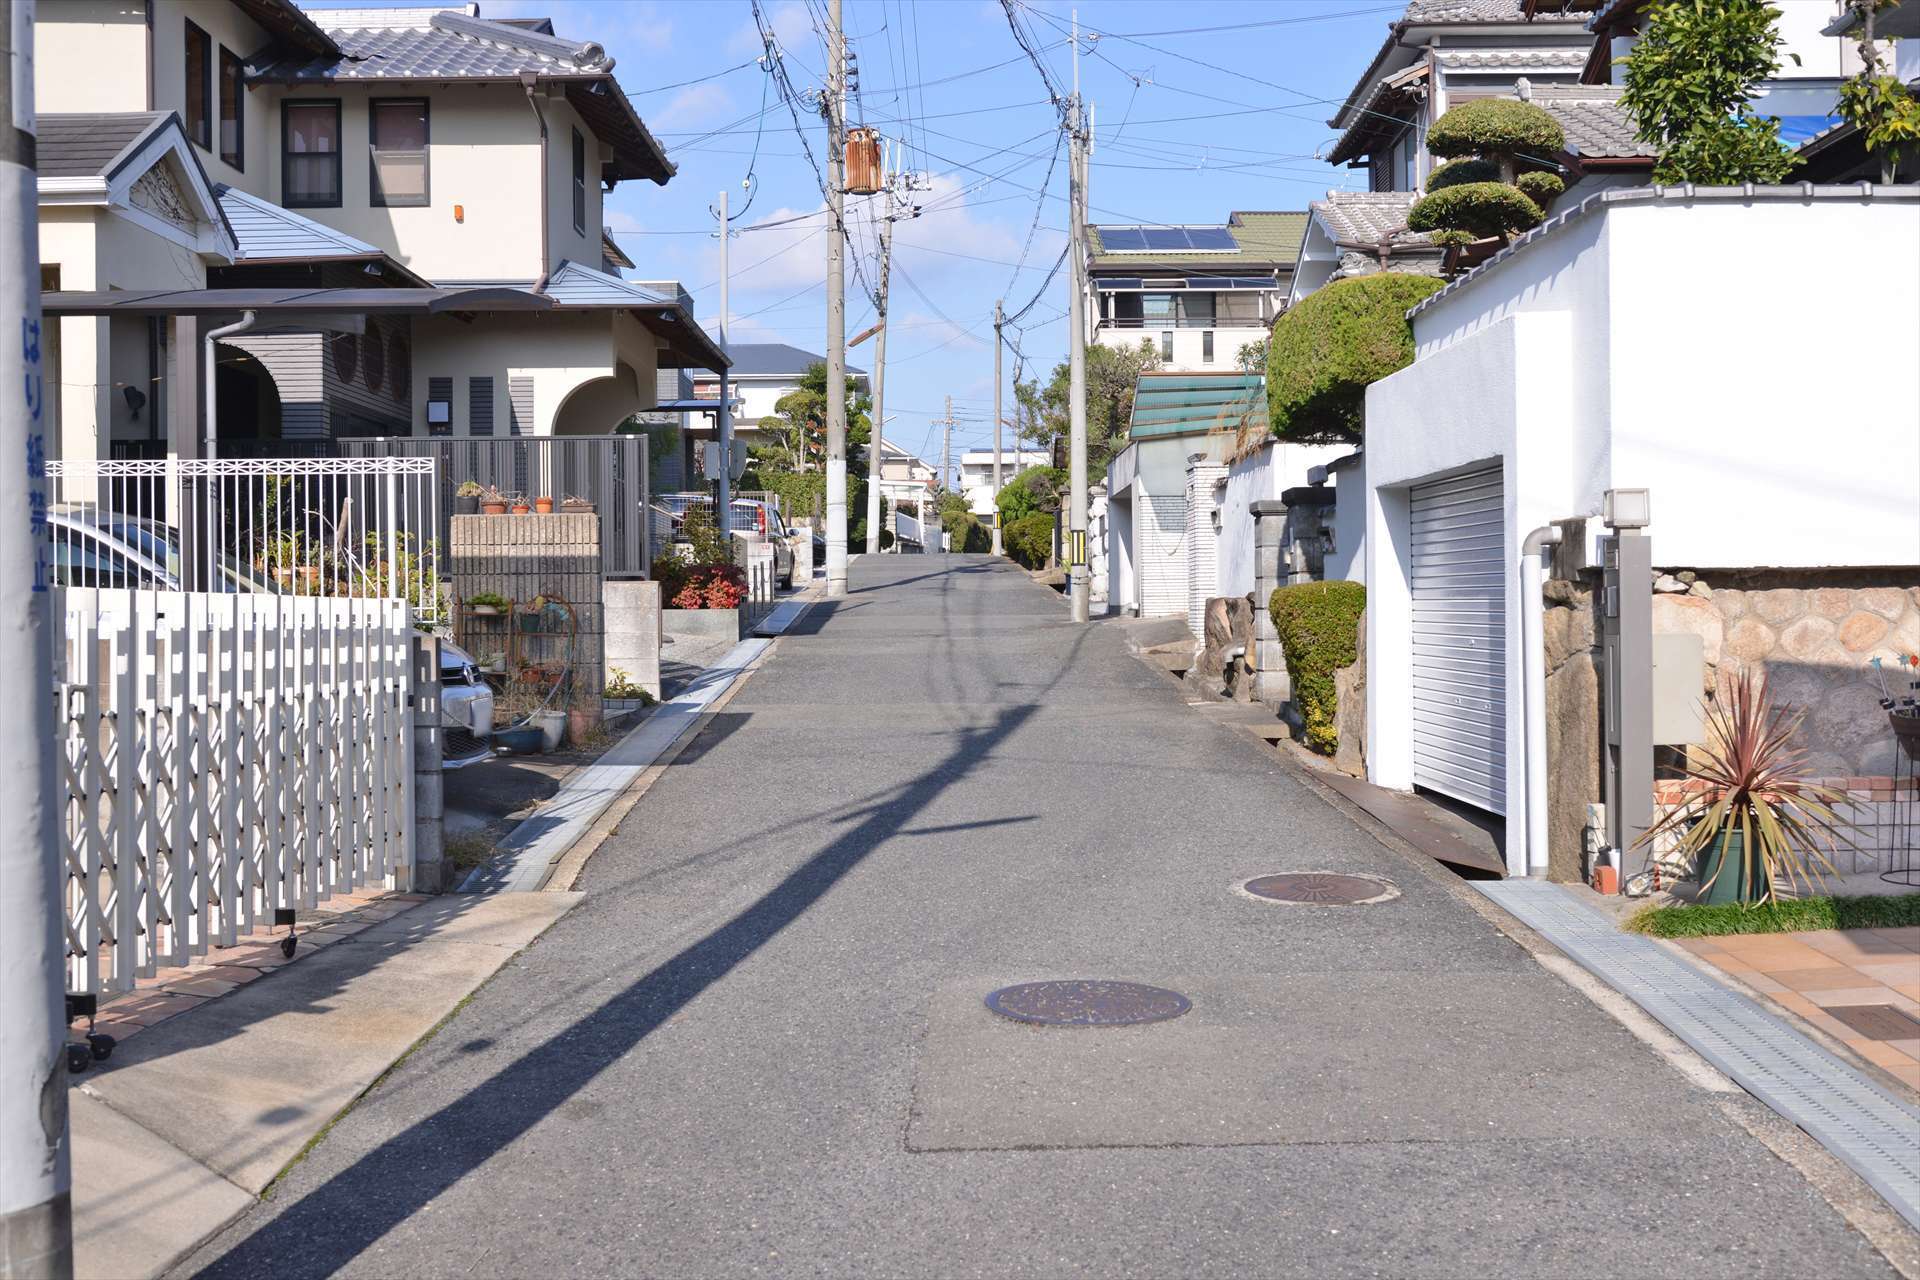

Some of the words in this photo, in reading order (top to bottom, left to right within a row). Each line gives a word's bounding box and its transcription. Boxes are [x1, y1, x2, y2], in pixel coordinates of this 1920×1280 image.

[22, 317, 48, 592] はり紙禁止
